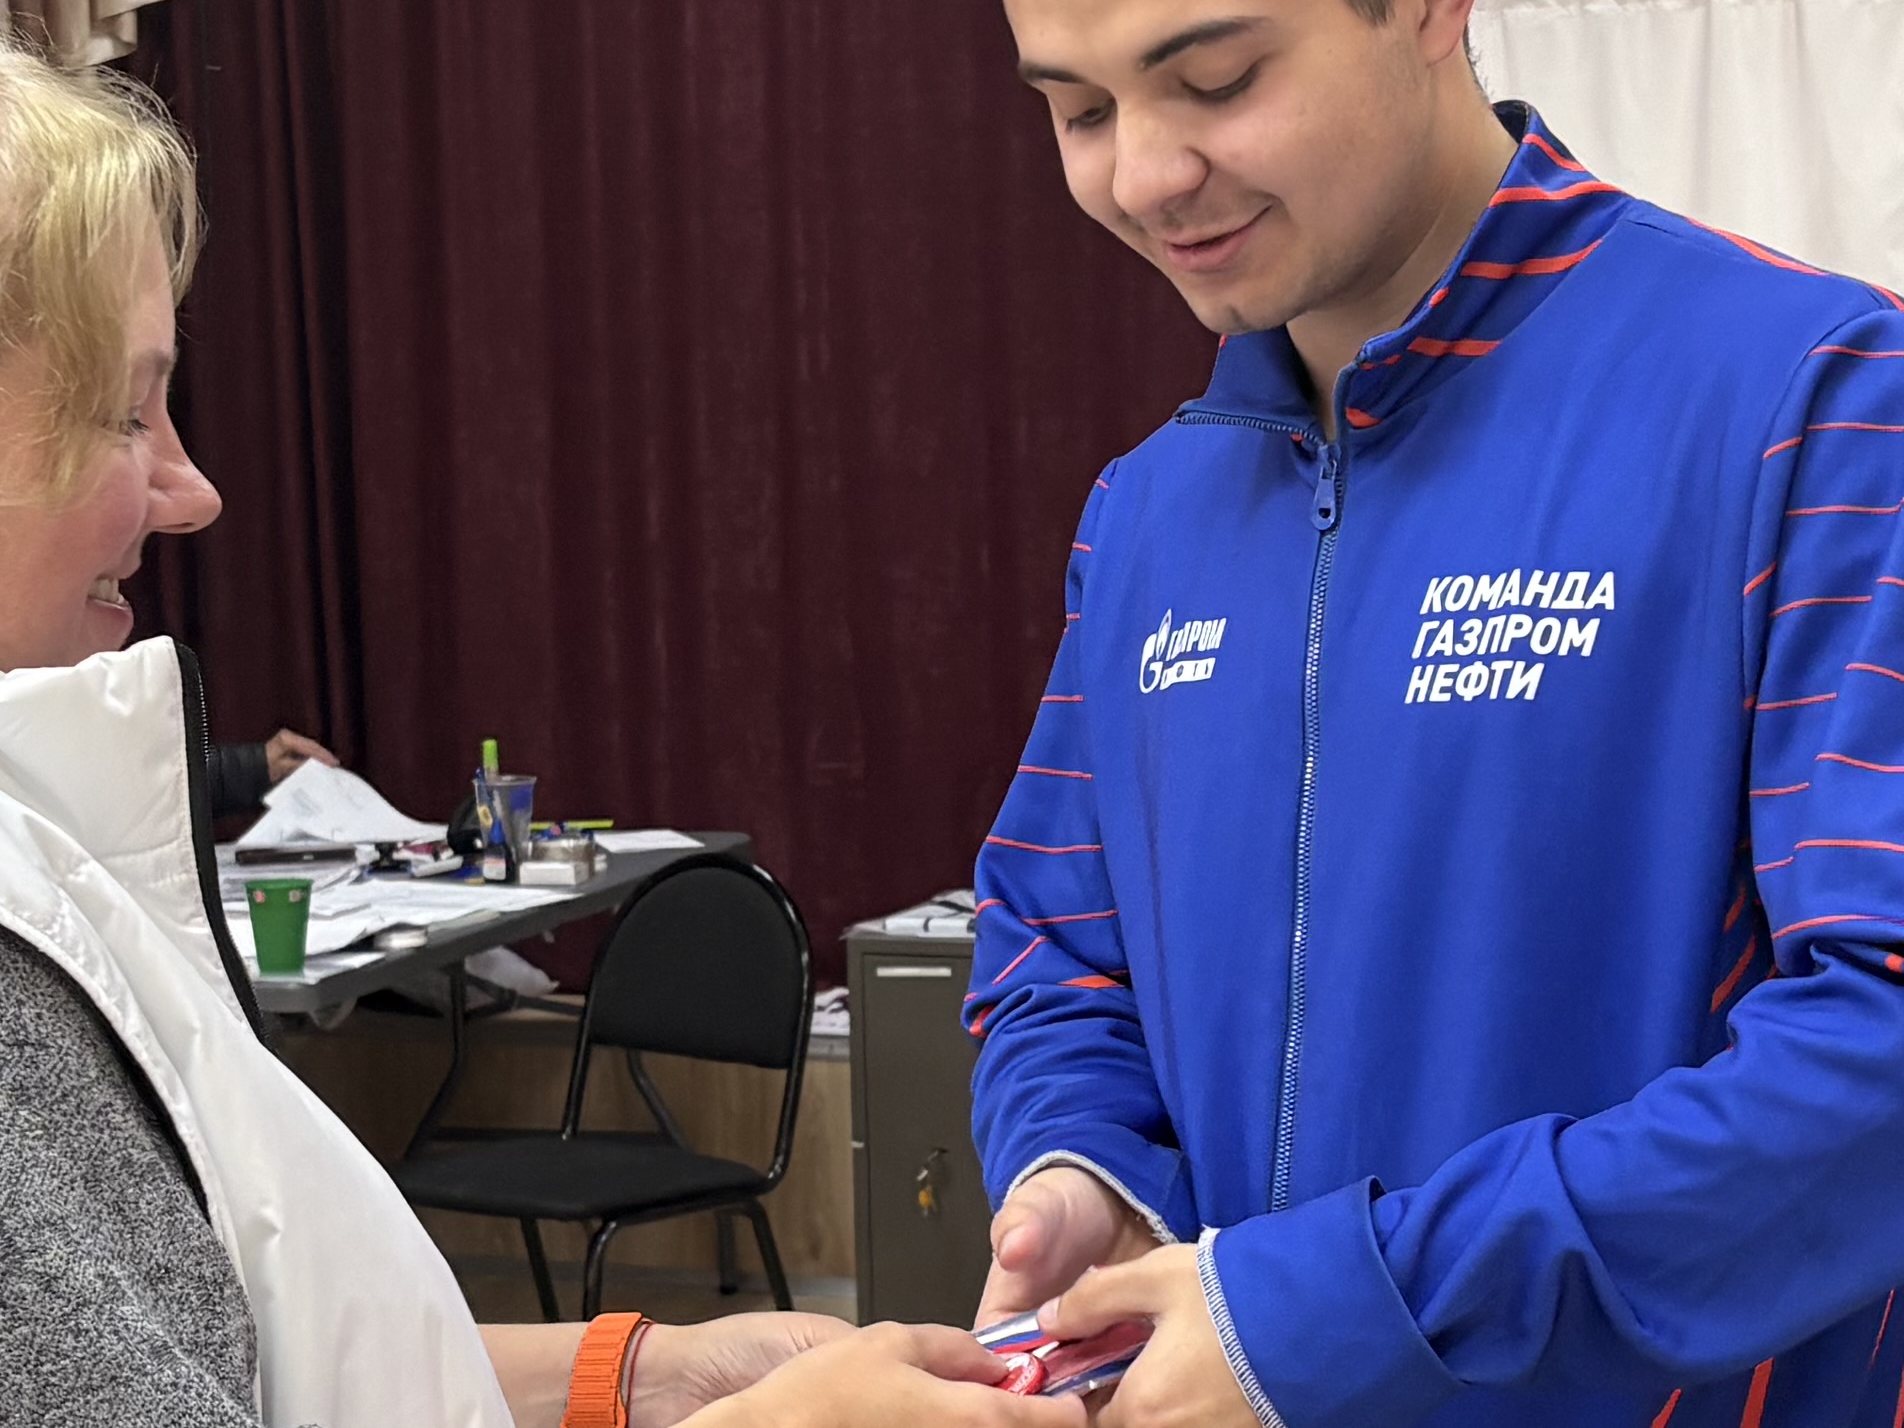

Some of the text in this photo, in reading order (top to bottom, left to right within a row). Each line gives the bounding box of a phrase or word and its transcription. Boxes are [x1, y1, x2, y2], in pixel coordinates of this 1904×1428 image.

[1419, 568, 1616, 614] КОМАНДА
[1411, 613, 1601, 660] ГАЗПРОМ
[1404, 661, 1543, 704] НЕФТИ
